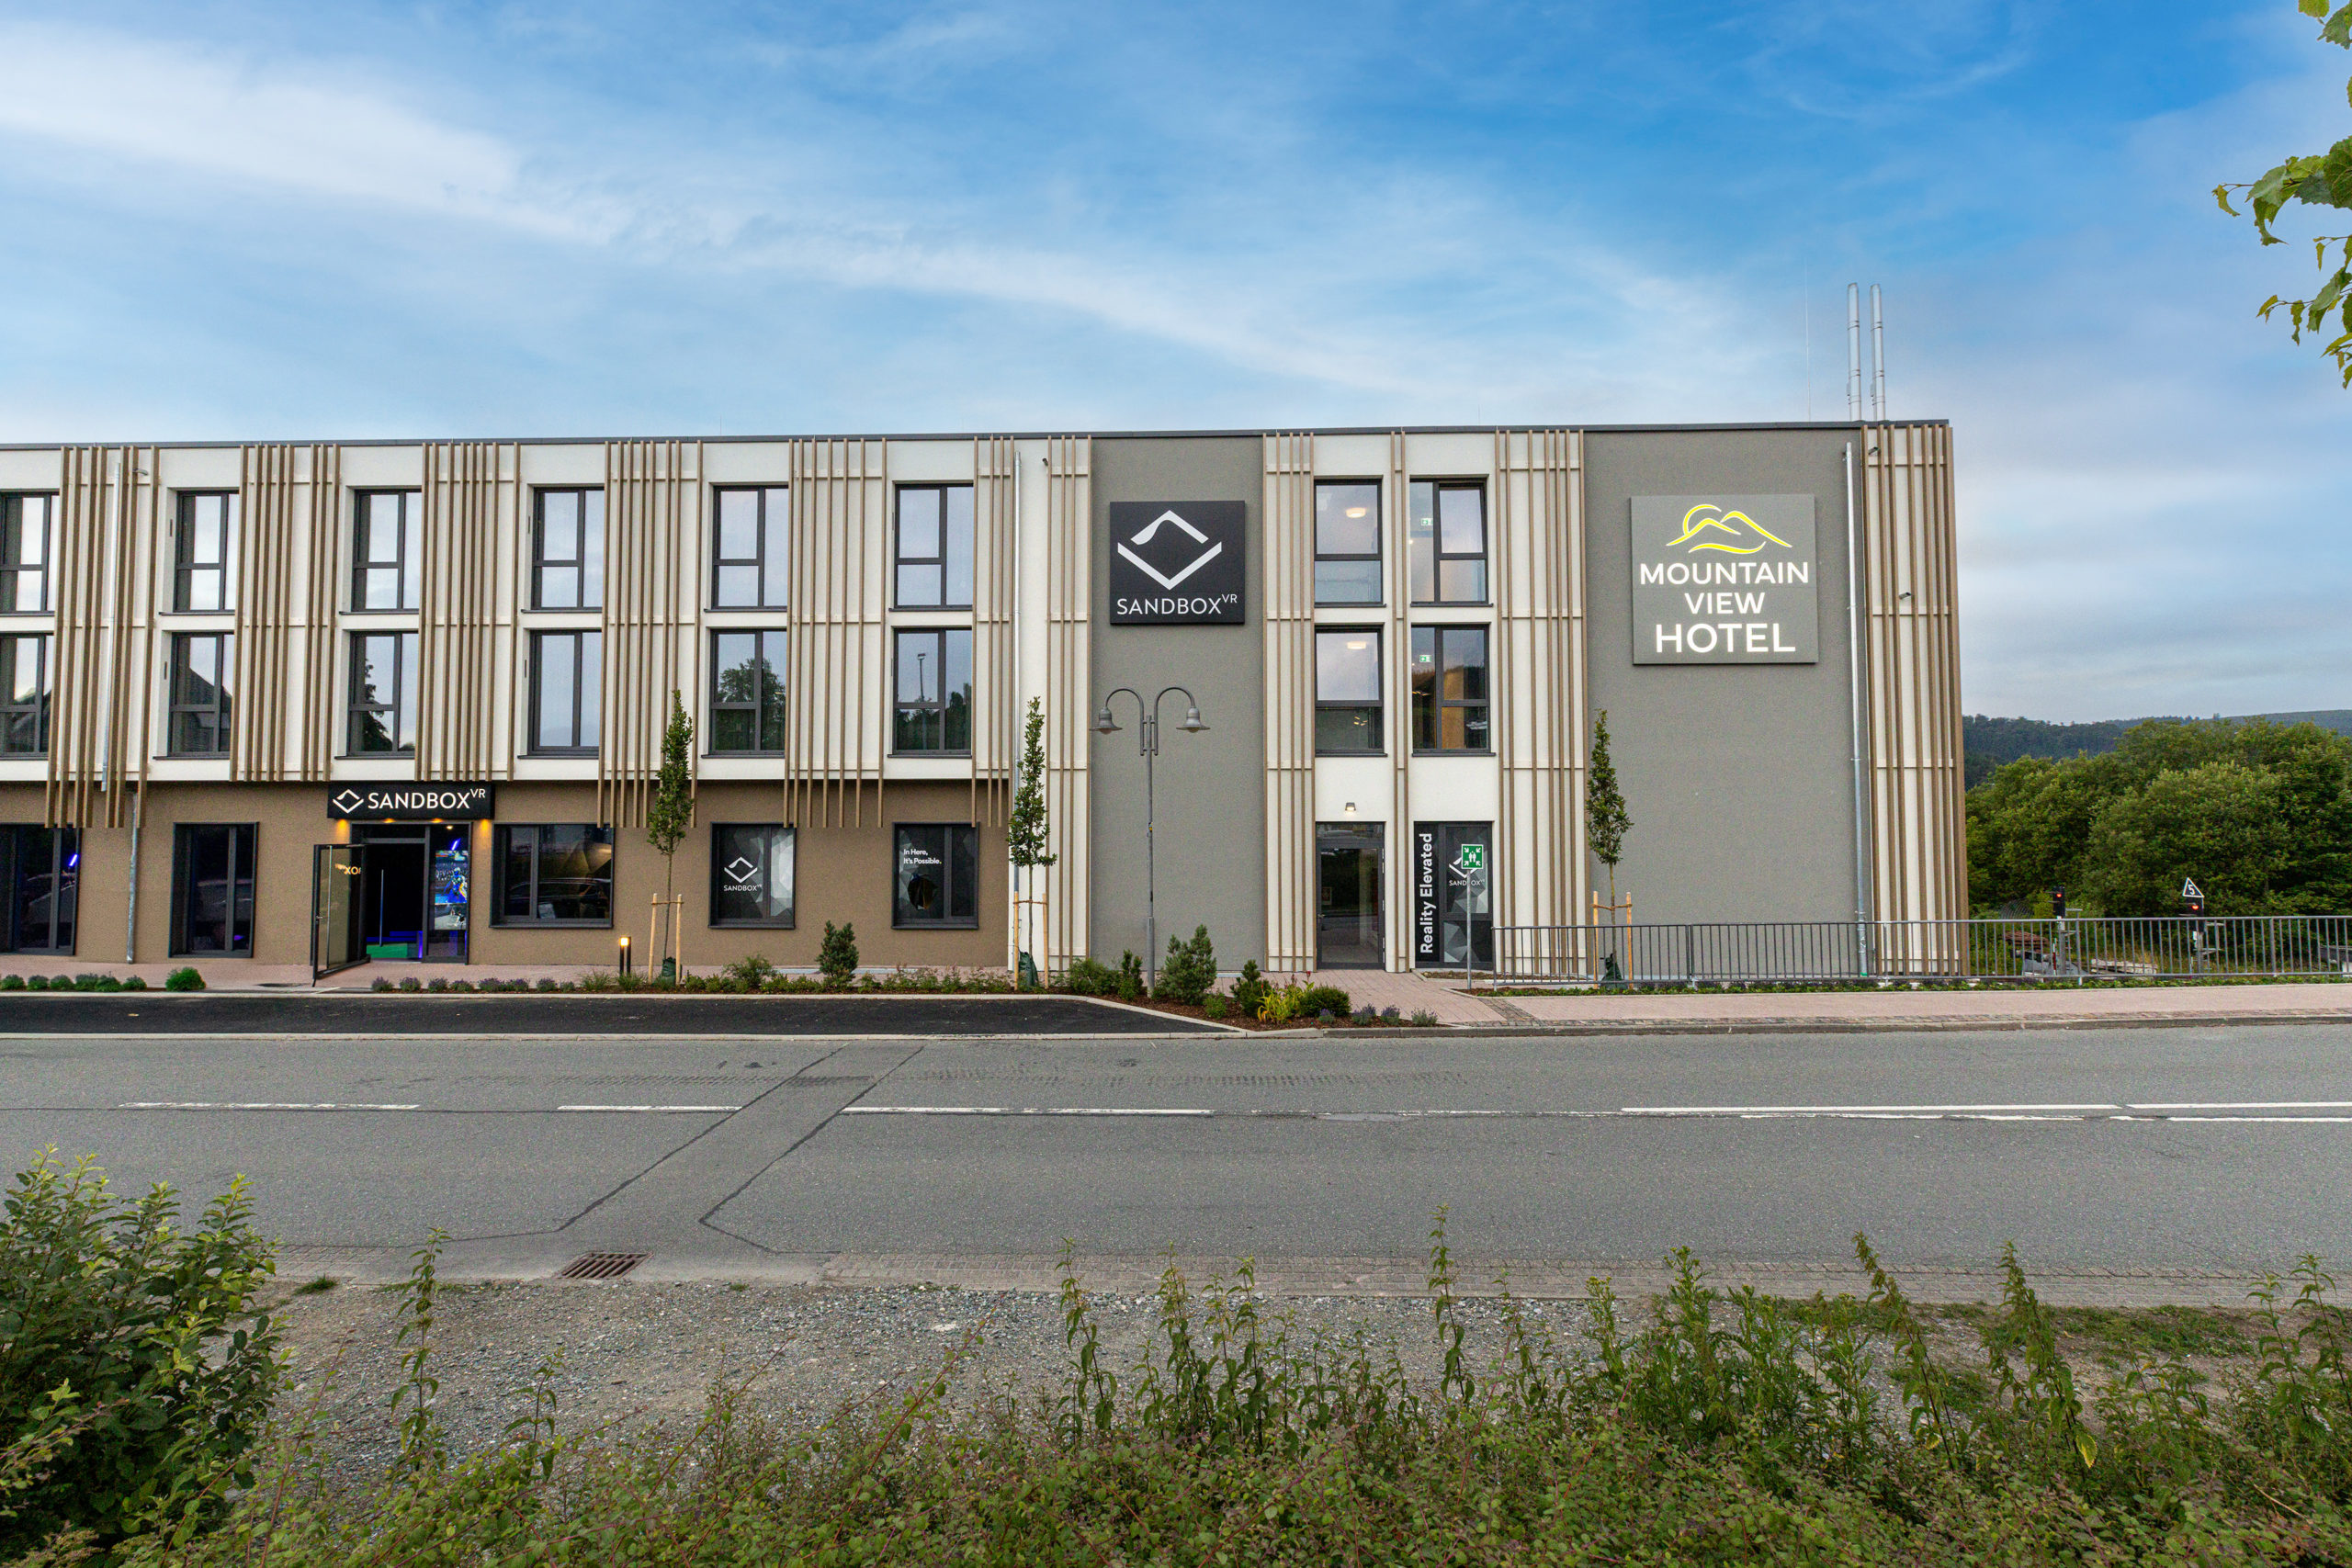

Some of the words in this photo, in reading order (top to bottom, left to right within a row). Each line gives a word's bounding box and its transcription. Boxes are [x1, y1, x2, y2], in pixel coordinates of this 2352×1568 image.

[1640, 562, 1809, 585] MOUNTAIN
[1684, 592, 1766, 615] VIEW
[1656, 623, 1796, 653] HOTEL
[1419, 832, 1433, 897] Elevated
[2188, 884, 2195, 895] 5
[1419, 900, 1437, 953] Reality
